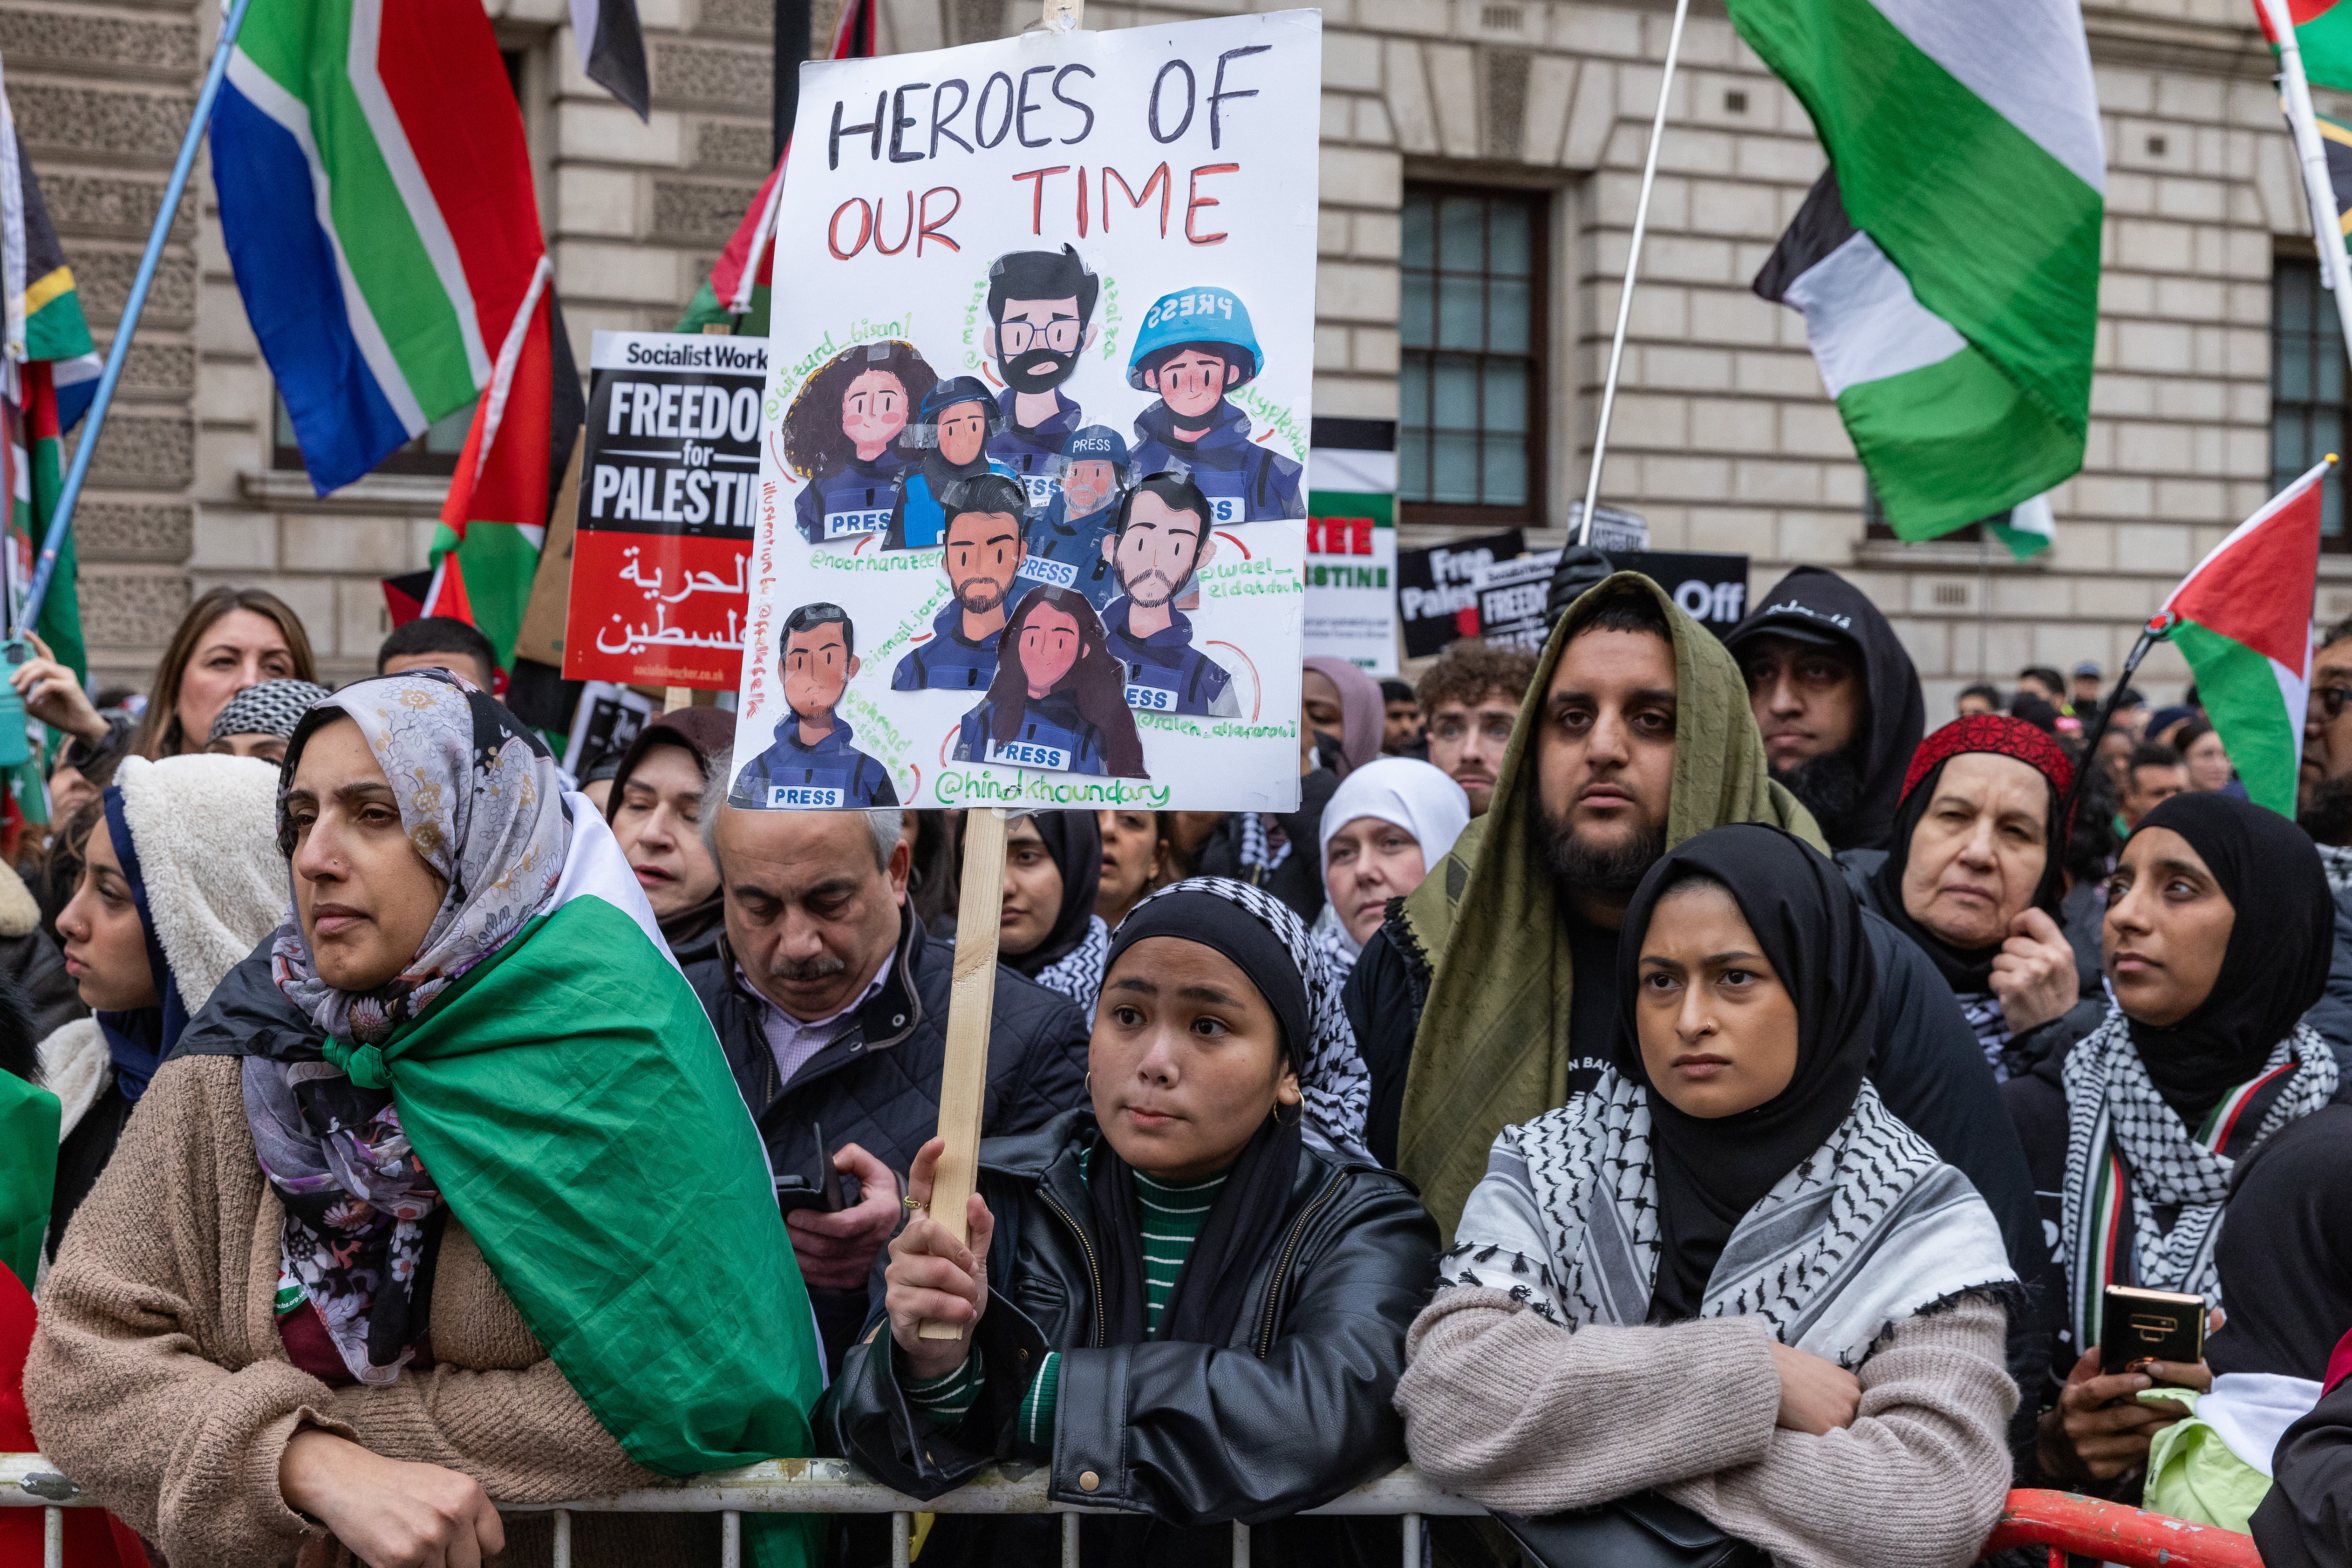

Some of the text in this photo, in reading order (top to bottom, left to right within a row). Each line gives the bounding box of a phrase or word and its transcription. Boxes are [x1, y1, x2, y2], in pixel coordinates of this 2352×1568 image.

[828, 44, 1273, 170] HEROES OF
[827, 161, 1240, 260] OUR TIME
[627, 341, 712, 367] Socialist
[682, 438, 714, 466] for
[1072, 438, 1111, 453] PRESS
[1305, 565, 1387, 587] STINE
[1674, 579, 1745, 623] Off
[993, 744, 1061, 767] PRESS
[775, 789, 836, 805] PRESS
[935, 769, 1171, 809] @hindkhoundary
